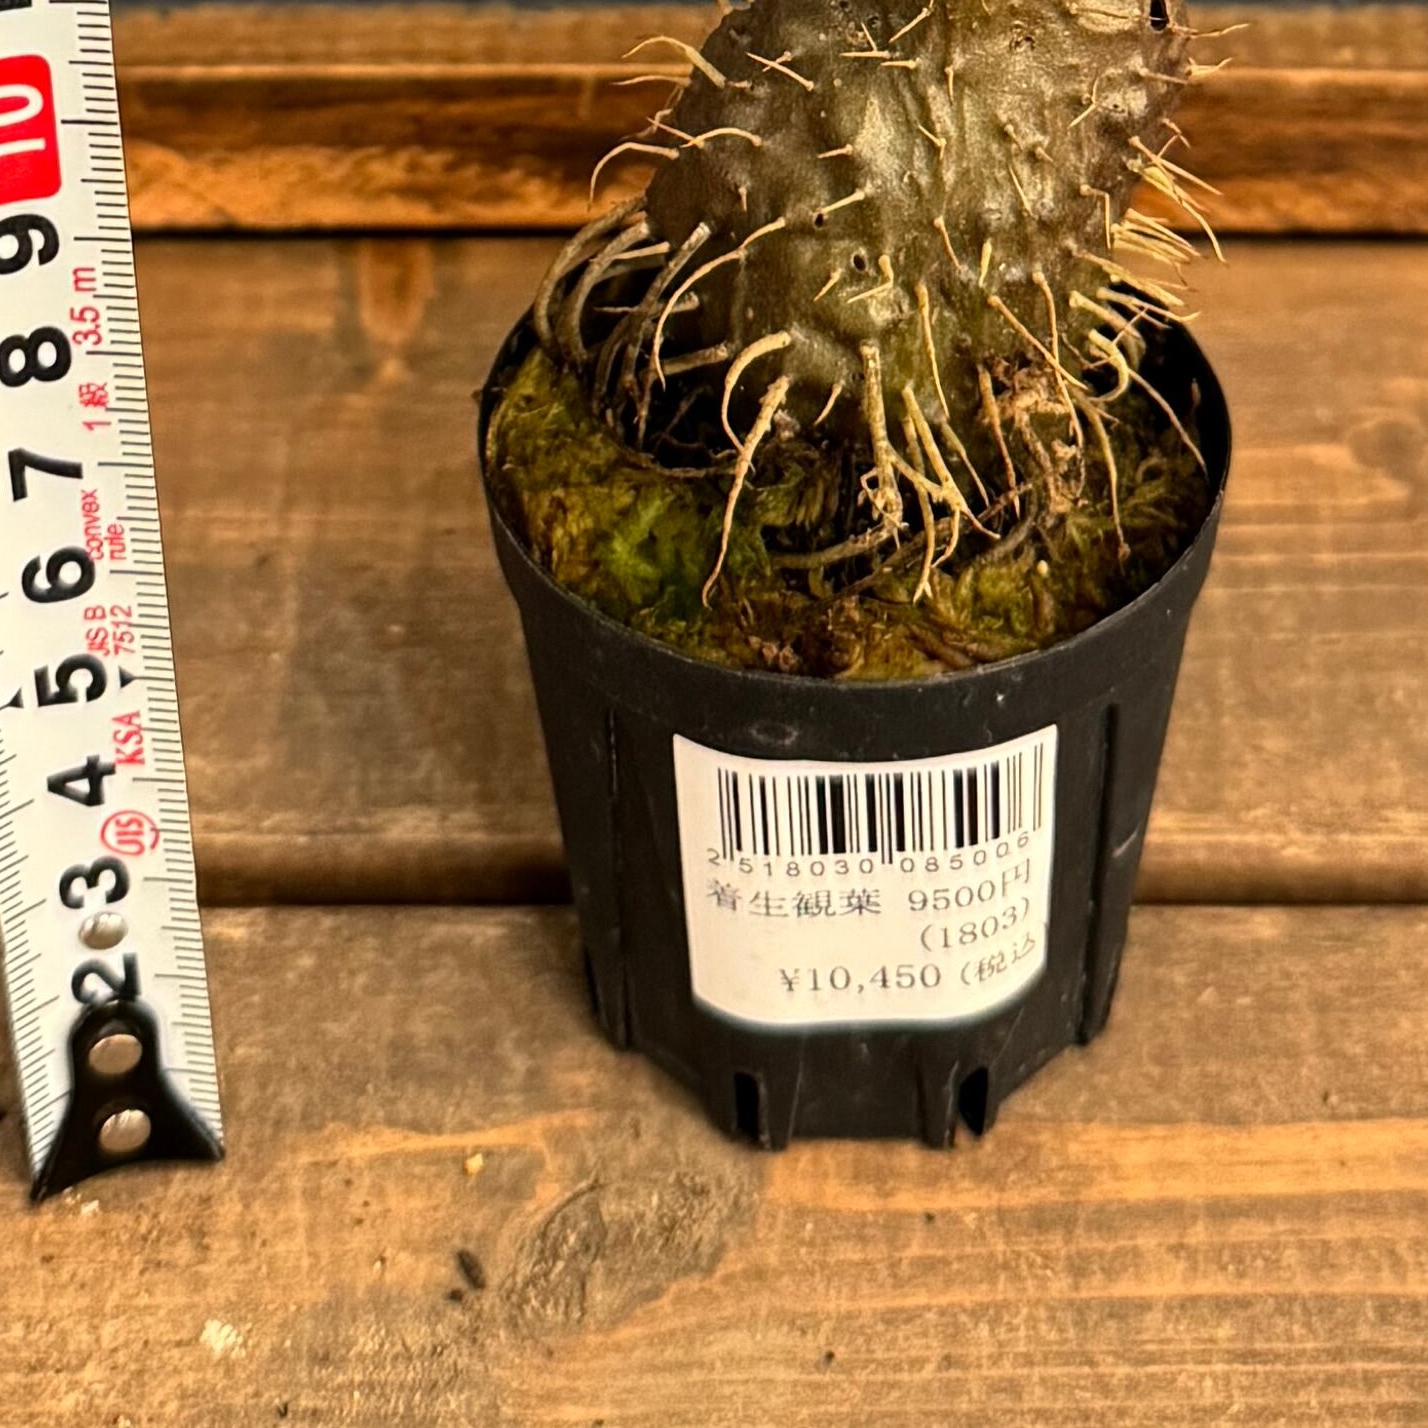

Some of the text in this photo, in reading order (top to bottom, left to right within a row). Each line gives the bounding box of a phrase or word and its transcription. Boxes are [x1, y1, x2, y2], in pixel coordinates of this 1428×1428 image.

[7, 448, 83, 502] 7
[81, 488, 104, 561] convex
[21, 545, 96, 603] 6
[110, 605, 135, 656] 7512
[34, 653, 107, 708] 5
[112, 710, 145, 765] KSA
[47, 753, 116, 806] 4
[58, 856, 130, 909] 3
[908, 858, 1031, 912] 9500円
[920, 897, 1030, 952] (1803)
[70, 951, 144, 1007] 2
[779, 963, 942, 994] ¥10,450
